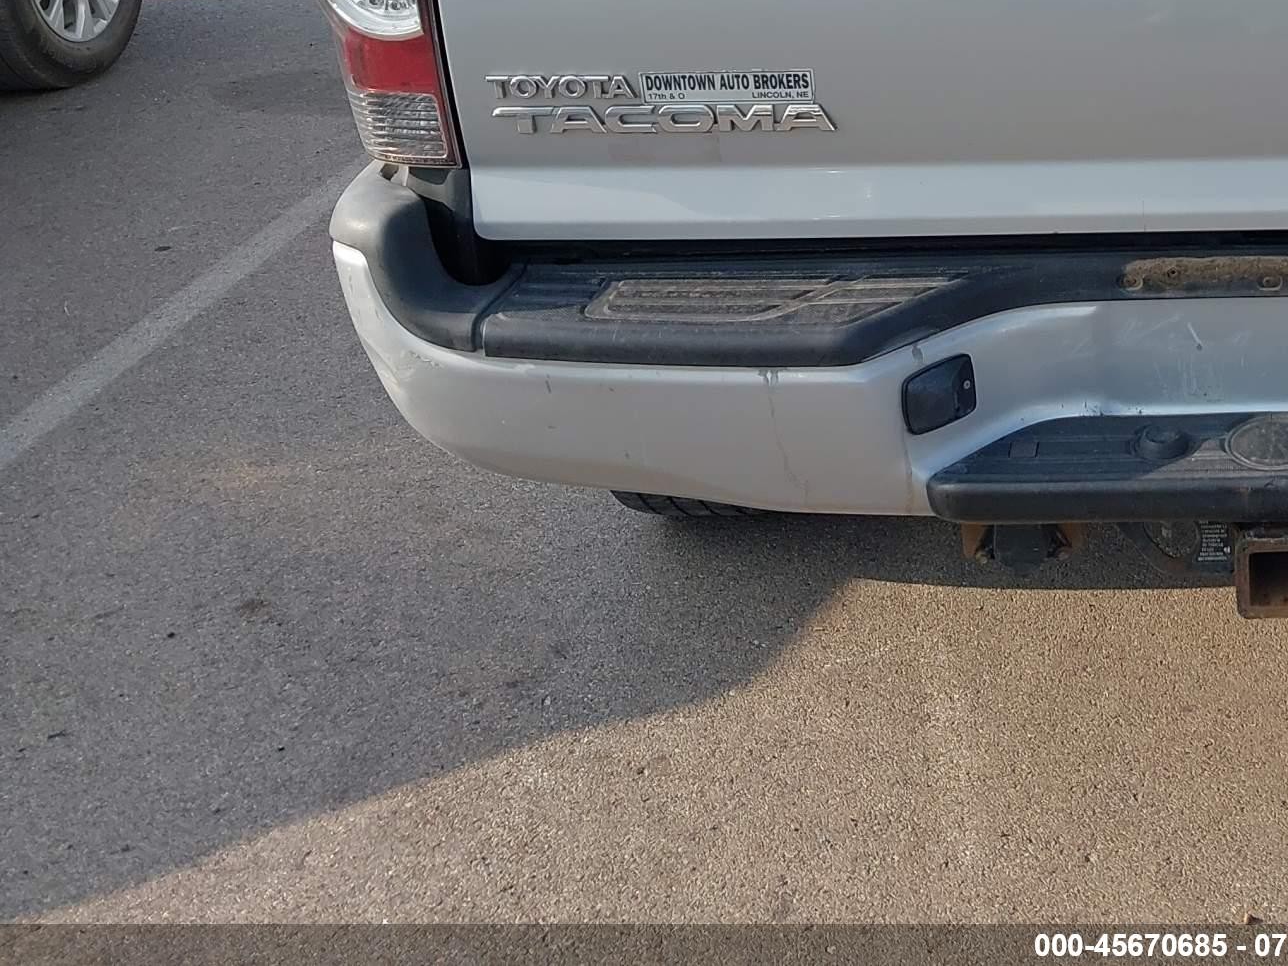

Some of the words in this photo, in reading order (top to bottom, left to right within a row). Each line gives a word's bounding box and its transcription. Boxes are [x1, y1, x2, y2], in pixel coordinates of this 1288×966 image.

[486, 74, 638, 98] TOYOTA
[645, 74, 716, 91] DOWNTOWN
[720, 74, 750, 90] AUTO
[753, 73, 809, 90] BROKERS
[492, 105, 837, 134] TACOMA
